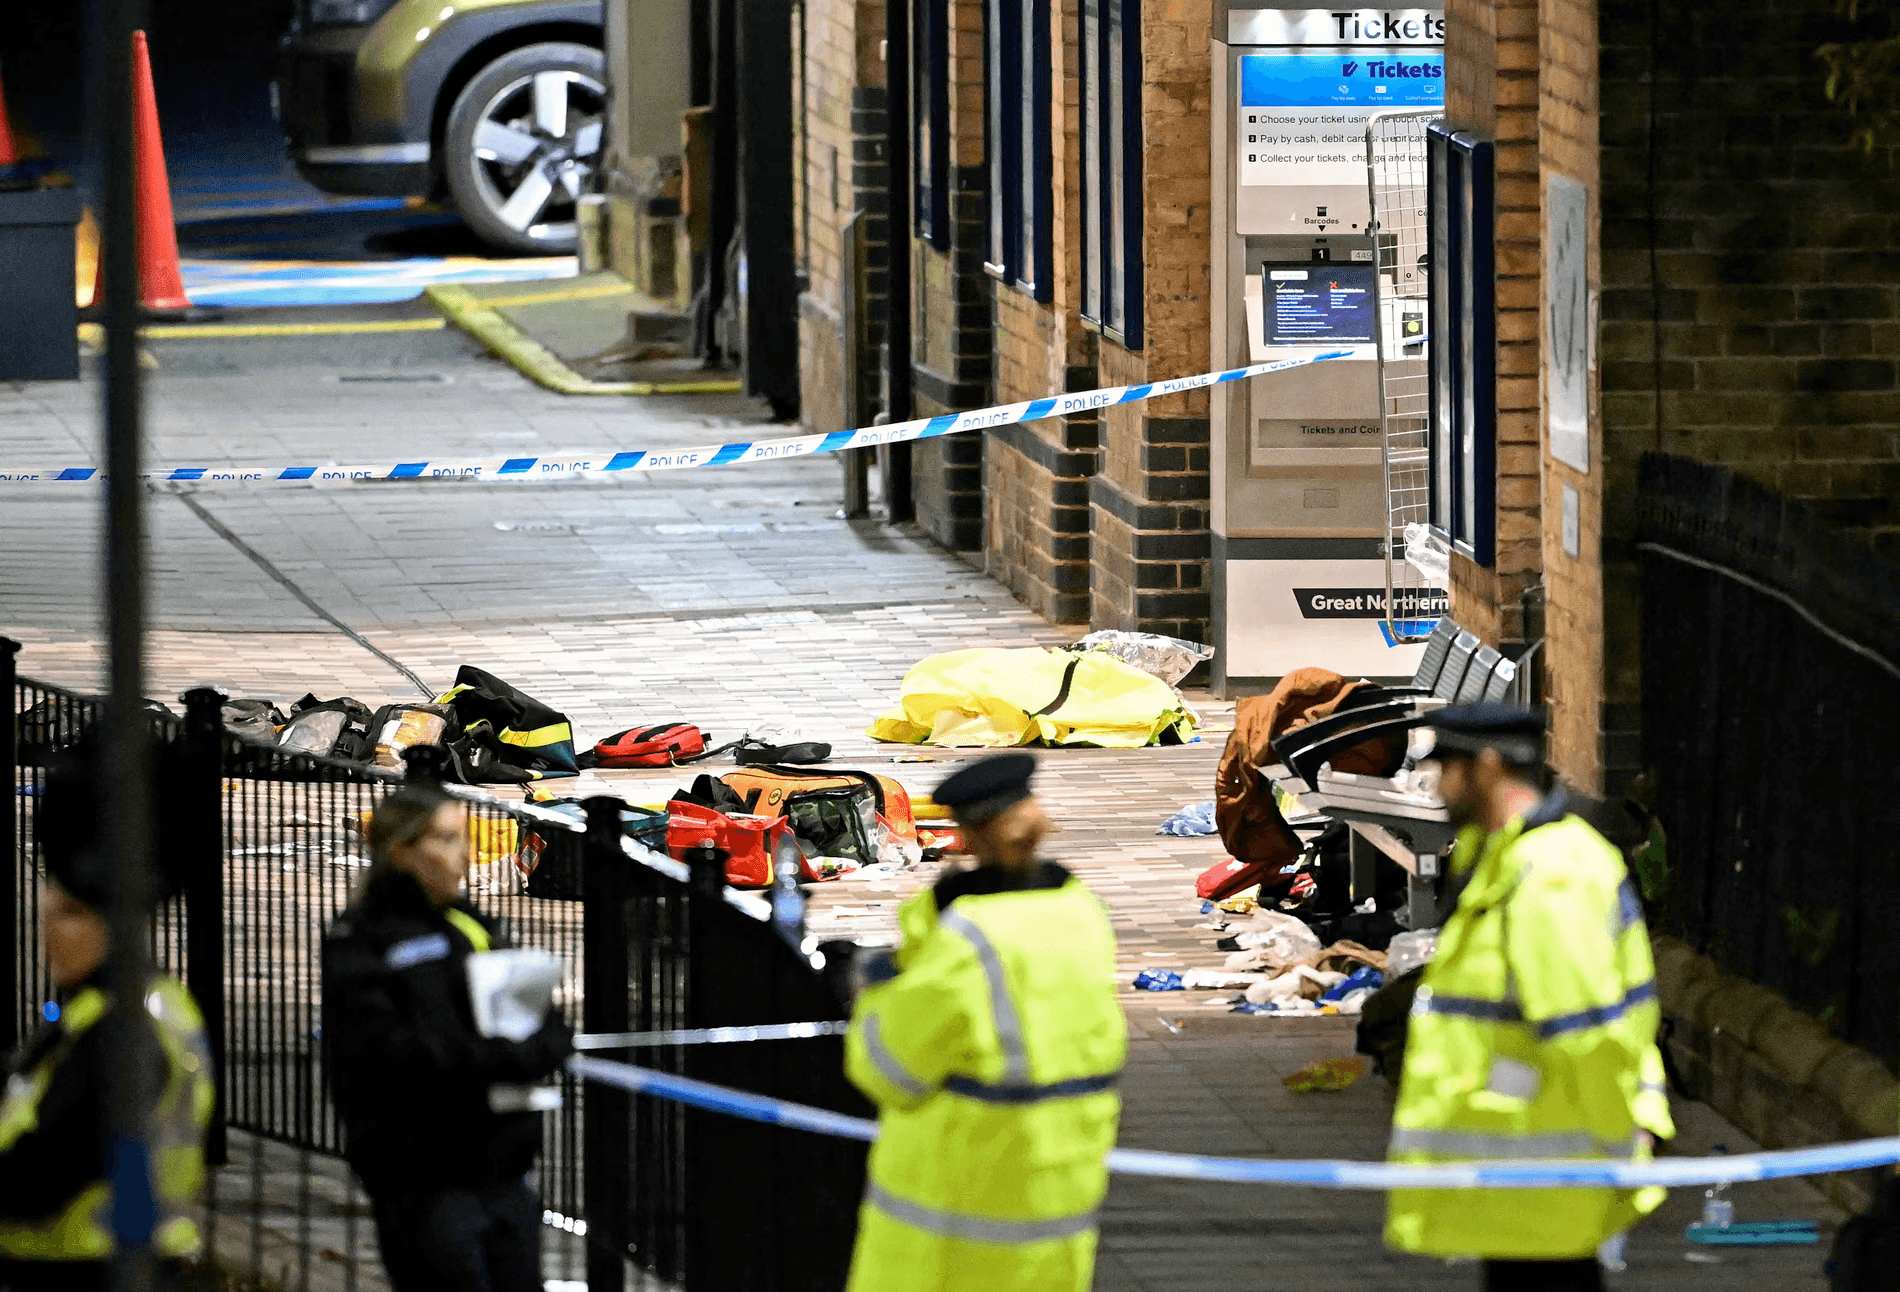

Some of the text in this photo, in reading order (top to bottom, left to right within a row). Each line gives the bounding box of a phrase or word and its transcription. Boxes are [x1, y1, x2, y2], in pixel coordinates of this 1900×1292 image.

[1331, 12, 1445, 39] Tickets
[1366, 61, 1442, 78] Tickets
[1260, 114, 1296, 124] Choose
[1298, 116, 1319, 125] your
[1321, 114, 1345, 124] ticket
[1260, 135, 1278, 145] Pay
[1281, 134, 1292, 145] by
[1294, 134, 1319, 143] cash,
[1321, 134, 1344, 142] debit
[1260, 153, 1292, 162] Collect
[1295, 155, 1314, 164] your
[1317, 154, 1348, 163] tickets,
[1352, 154, 1385, 164] chage
[1388, 154, 1405, 162] and
[1304, 217, 1339, 225] Barcodes
[1318, 249, 1324, 259] 1
[650, 454, 698, 467] POLICE
[756, 444, 803, 458] POLICE
[861, 429, 907, 444] POLICE
[963, 412, 1009, 429] POLICE
[1064, 393, 1109, 412] POLICE
[1163, 377, 1208, 393] POLICE
[1300, 425, 1336, 434] Tickets
[1339, 425, 1357, 434] and
[1311, 594, 1363, 610] Great
